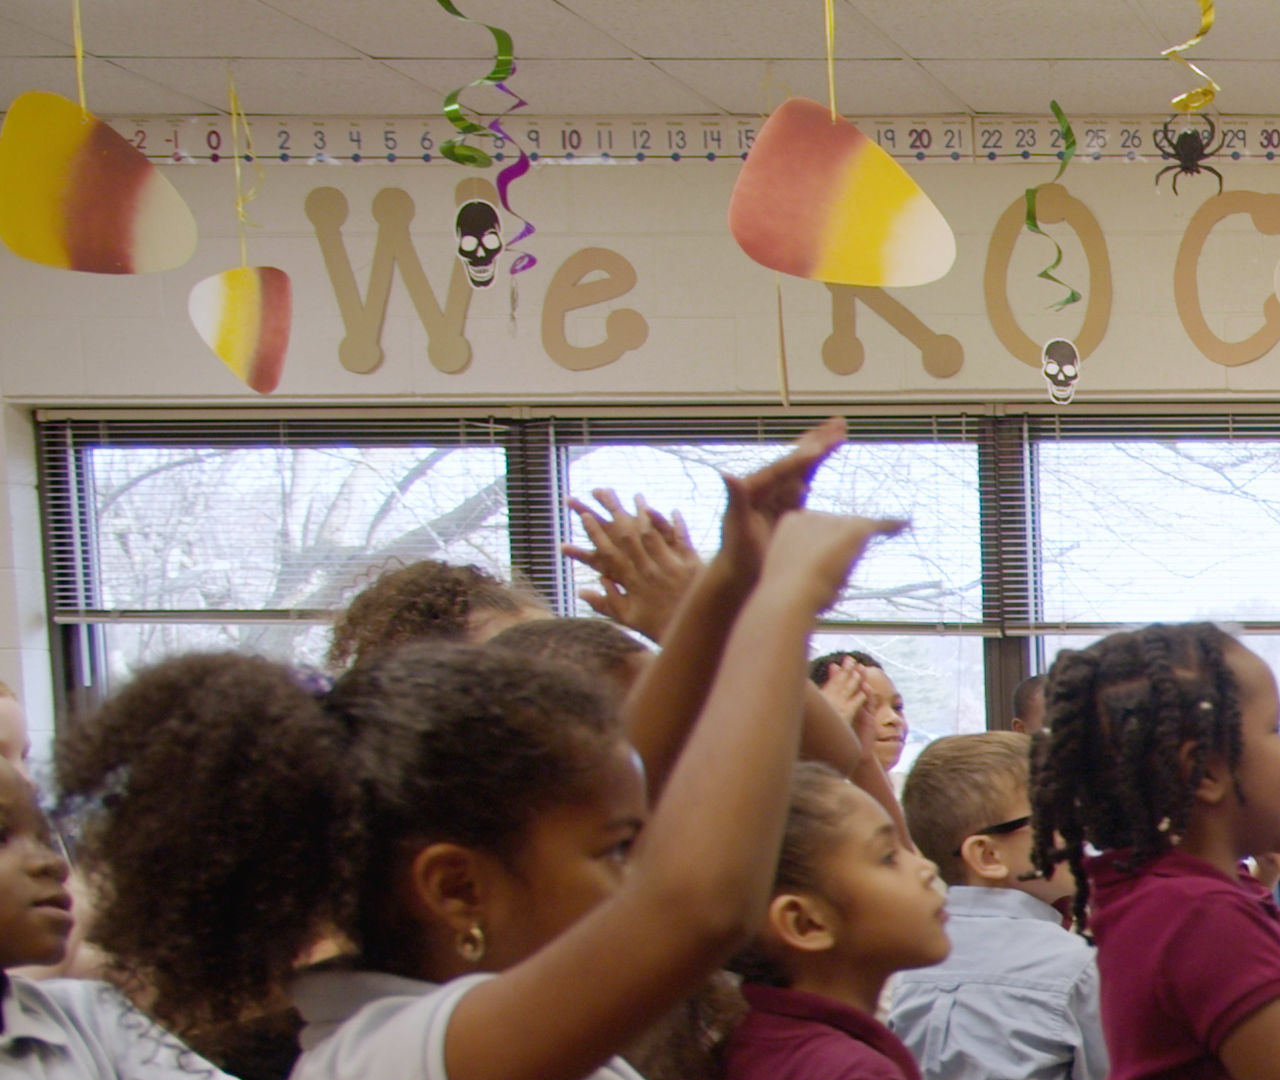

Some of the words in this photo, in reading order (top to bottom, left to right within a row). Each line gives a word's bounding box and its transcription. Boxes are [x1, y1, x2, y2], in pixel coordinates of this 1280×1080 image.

[129, 130, 147, 150] -2
[165, 130, 179, 149] -1
[207, 130, 221, 151] 0
[277, 131, 291, 150] 2
[313, 131, 326, 150] 3
[349, 131, 361, 150] 4
[384, 131, 397, 150] 5
[421, 131, 434, 150] 6
[527, 129, 541, 150] 9
[560, 129, 582, 150] 10
[598, 129, 613, 150] 11
[632, 129, 651, 150] 12
[667, 129, 687, 150] 13
[702, 129, 722, 150] 14
[737, 128, 755, 149] 15
[877, 128, 896, 149] 19
[909, 128, 932, 149] 20
[944, 129, 963, 149] 21
[981, 129, 1003, 150] 22
[1015, 129, 1036, 149] 23
[1085, 129, 1107, 149] 25
[1121, 129, 1142, 149] 26
[1226, 129, 1247, 149] 29
[1260, 129, 1280, 149] 30
[304, 177, 648, 374] We
